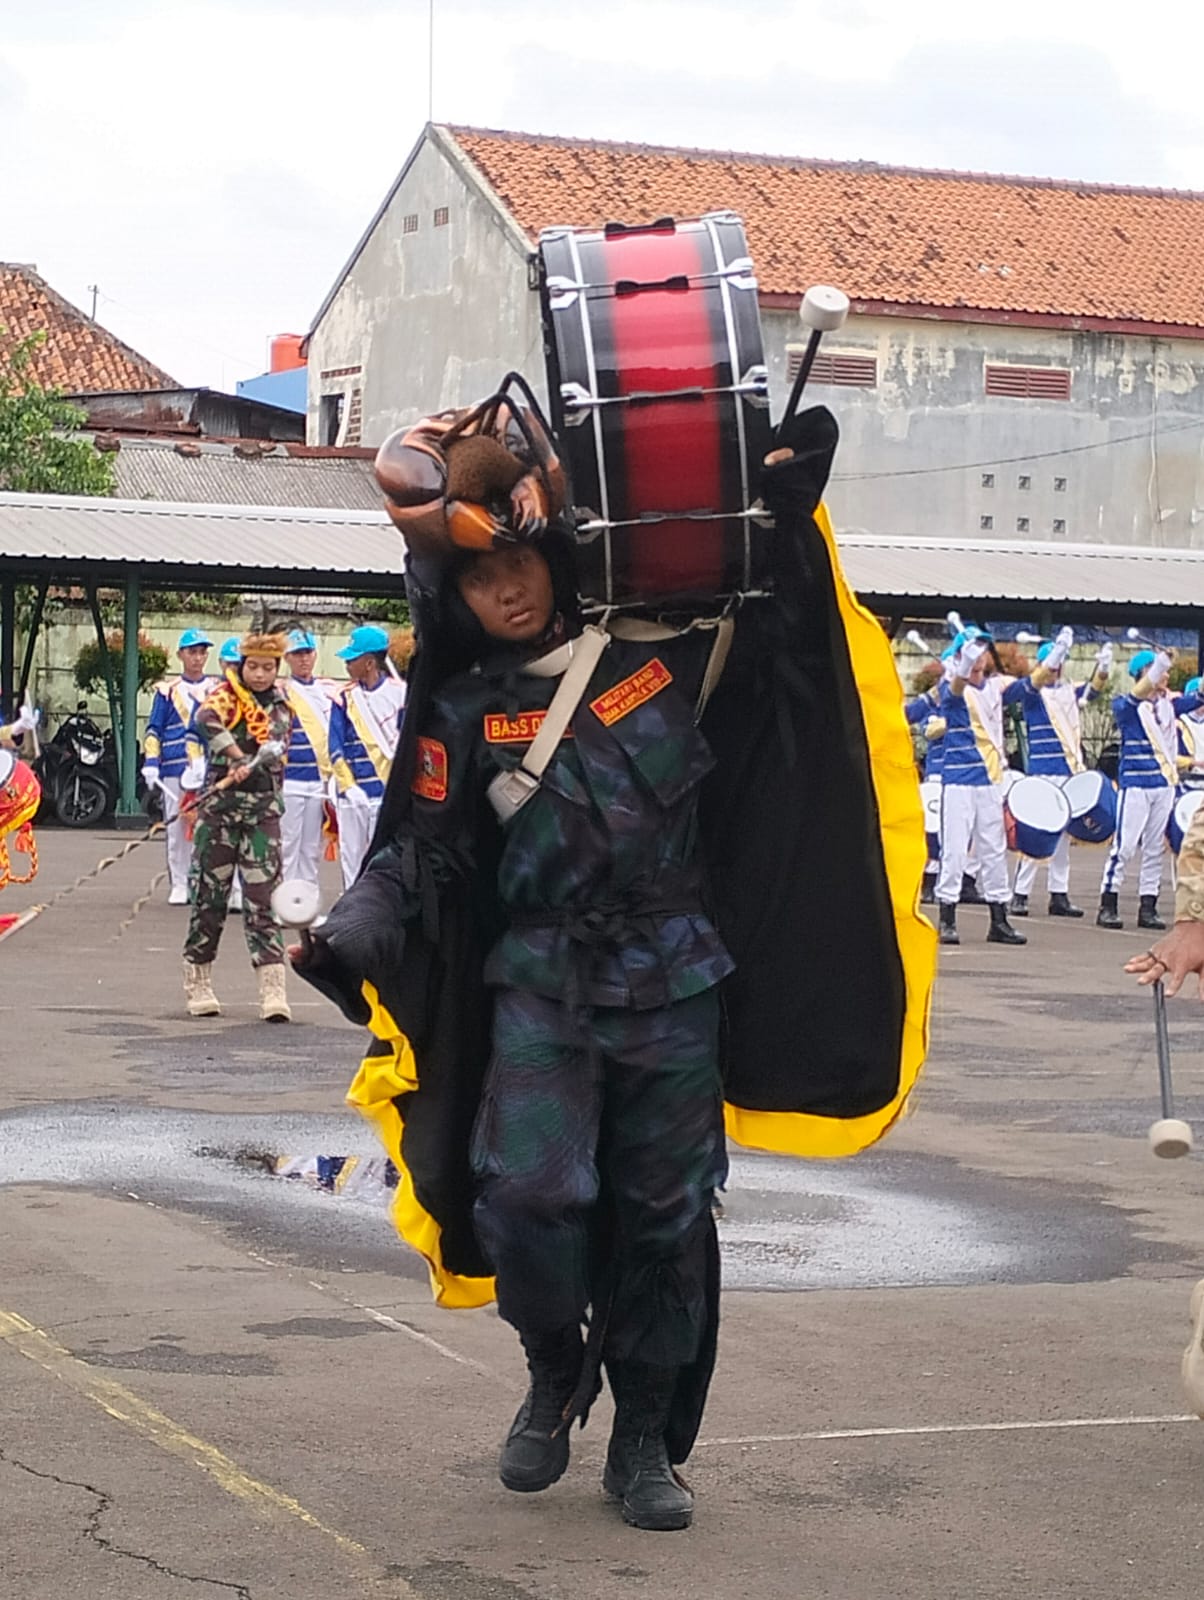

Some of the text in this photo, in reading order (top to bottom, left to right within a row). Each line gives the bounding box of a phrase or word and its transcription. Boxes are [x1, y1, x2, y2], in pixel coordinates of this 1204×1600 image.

[600, 669, 654, 709] MILITARY BAND
[491, 718, 529, 737] BASS
